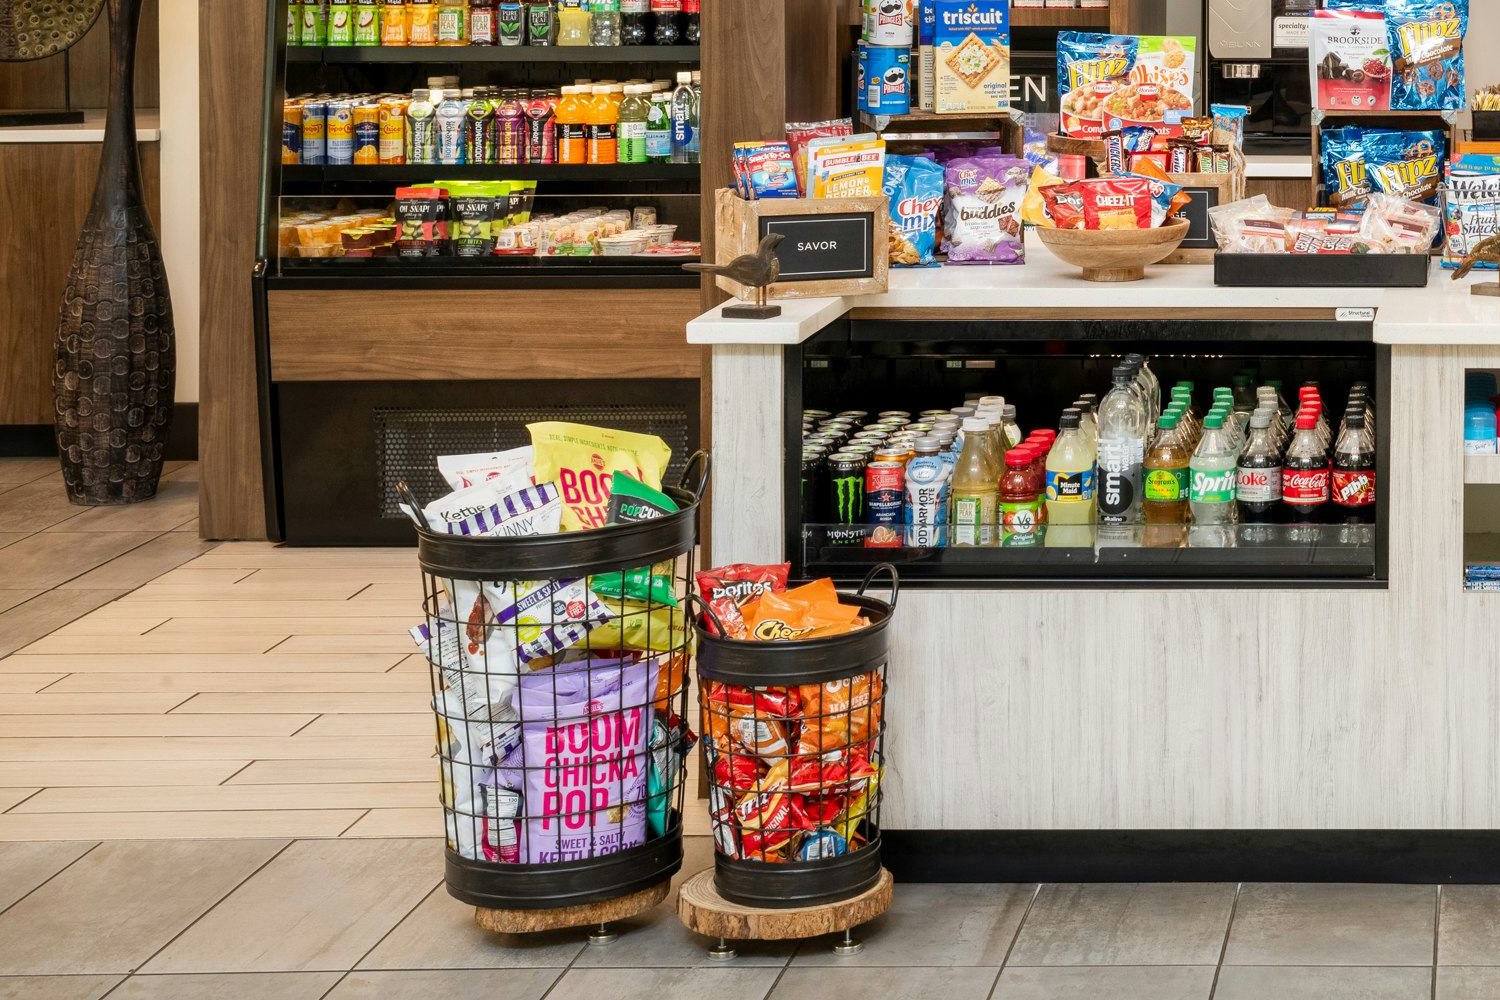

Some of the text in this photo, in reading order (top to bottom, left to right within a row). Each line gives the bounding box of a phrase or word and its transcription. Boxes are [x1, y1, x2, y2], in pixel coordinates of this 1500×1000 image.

[879, 14, 902, 25] PRINGLES
[943, 9, 1003, 25] triscuit
[1327, 36, 1383, 44] BROOKSIDE
[1398, 19, 1461, 58] Flipz
[883, 84, 905, 95] PRINGLES
[675, 101, 685, 141] smart
[825, 157, 856, 167] BUMBLE
[1109, 136, 1120, 172] SNICKERS
[958, 170, 978, 179] Chex
[1379, 155, 1438, 194] Flipz
[826, 178, 862, 194] LEMON
[898, 197, 942, 215] Chex
[1096, 195, 1134, 206] CHEEZ-IT
[960, 202, 1015, 221] buddies
[1470, 215, 1498, 225] Fruit
[903, 213, 936, 232] mix
[797, 240, 837, 251] SAVOR
[1105, 439, 1120, 506] smart
[1290, 473, 1327, 488] Coca-Cola
[1340, 475, 1370, 501] Pibb
[918, 488, 928, 548] BODYARMOR
[713, 581, 772, 599] Doritos
[516, 597, 537, 612] SWEET
[569, 605, 585, 617] FREE
[545, 706, 641, 754] BOOM
[544, 750, 638, 788] CHICKA
[542, 788, 609, 830] POP
[555, 831, 626, 850] SWEET SALTY
